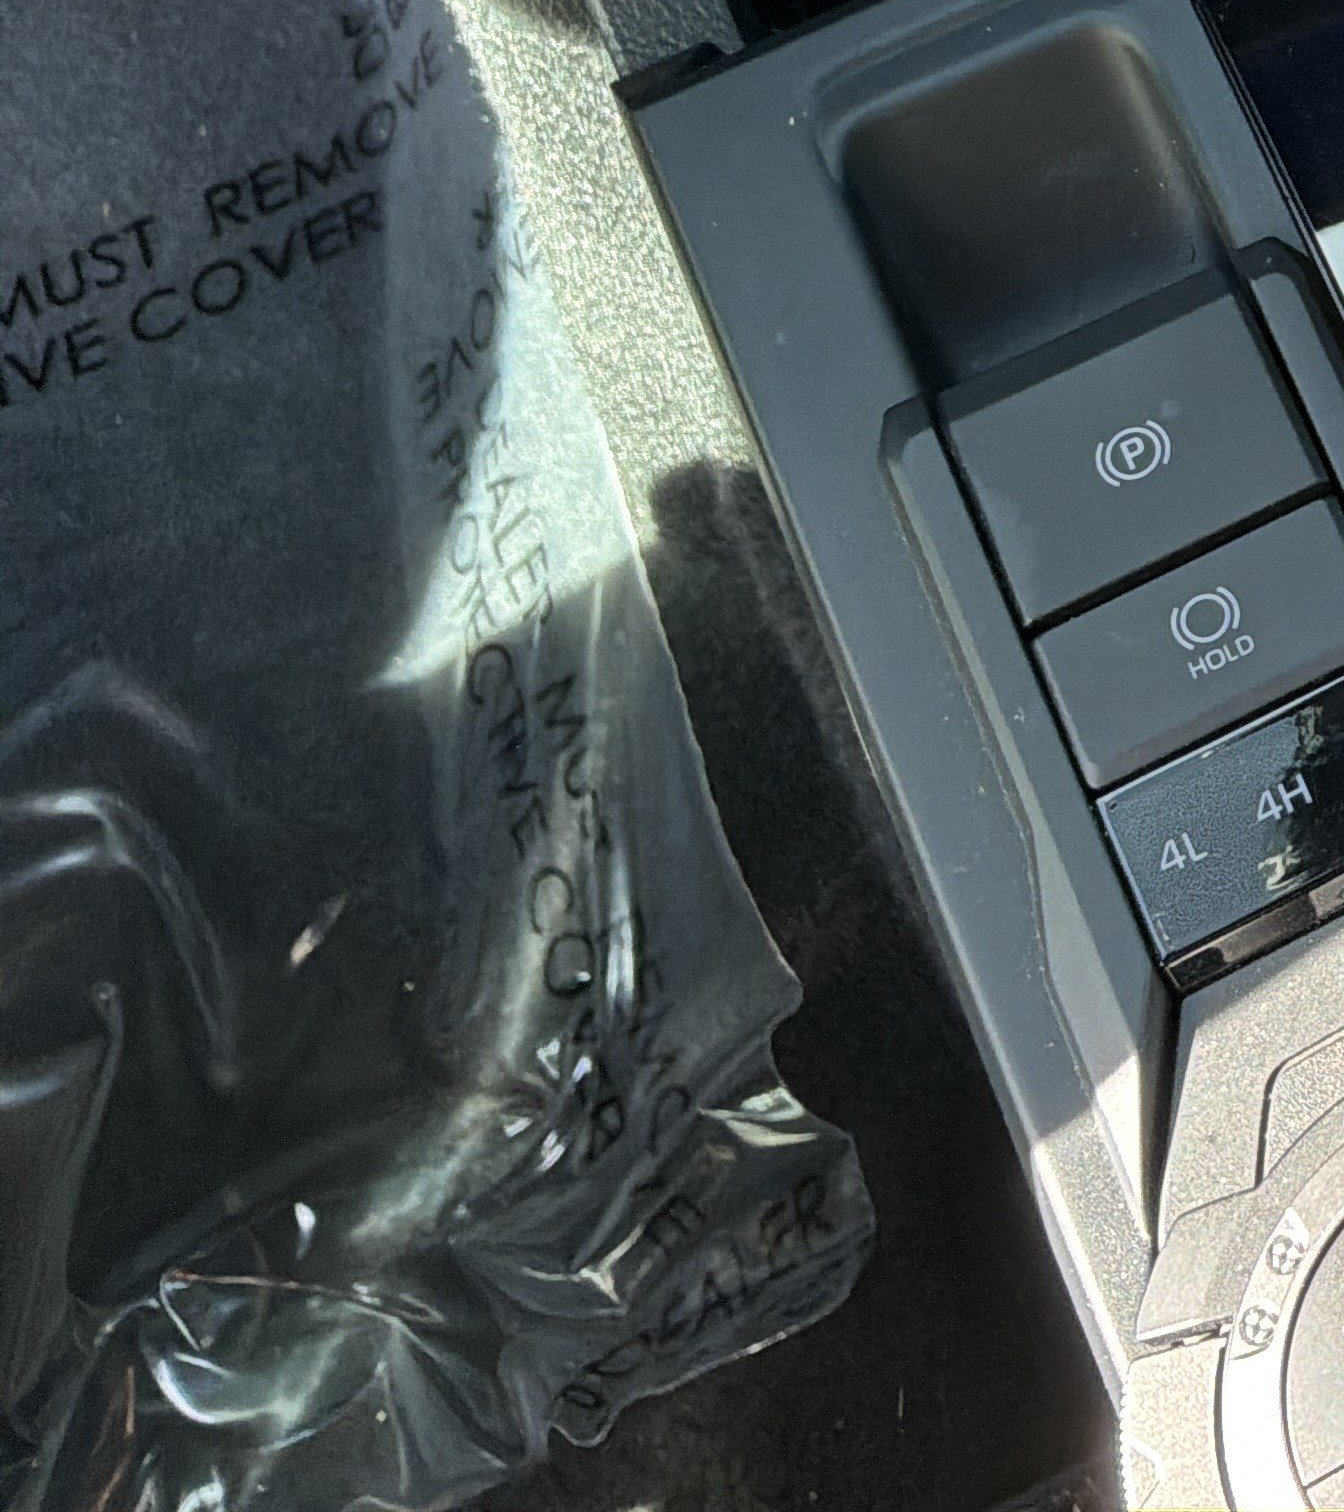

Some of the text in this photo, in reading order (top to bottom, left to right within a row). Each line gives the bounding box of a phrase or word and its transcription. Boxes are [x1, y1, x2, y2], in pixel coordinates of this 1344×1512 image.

[0, 29, 446, 329] MUST REMOVE
[130, 189, 386, 343] COVER
[1187, 634, 1256, 680] HOLD
[1256, 773, 1314, 825] 4H
[1159, 832, 1210, 873] 4L
